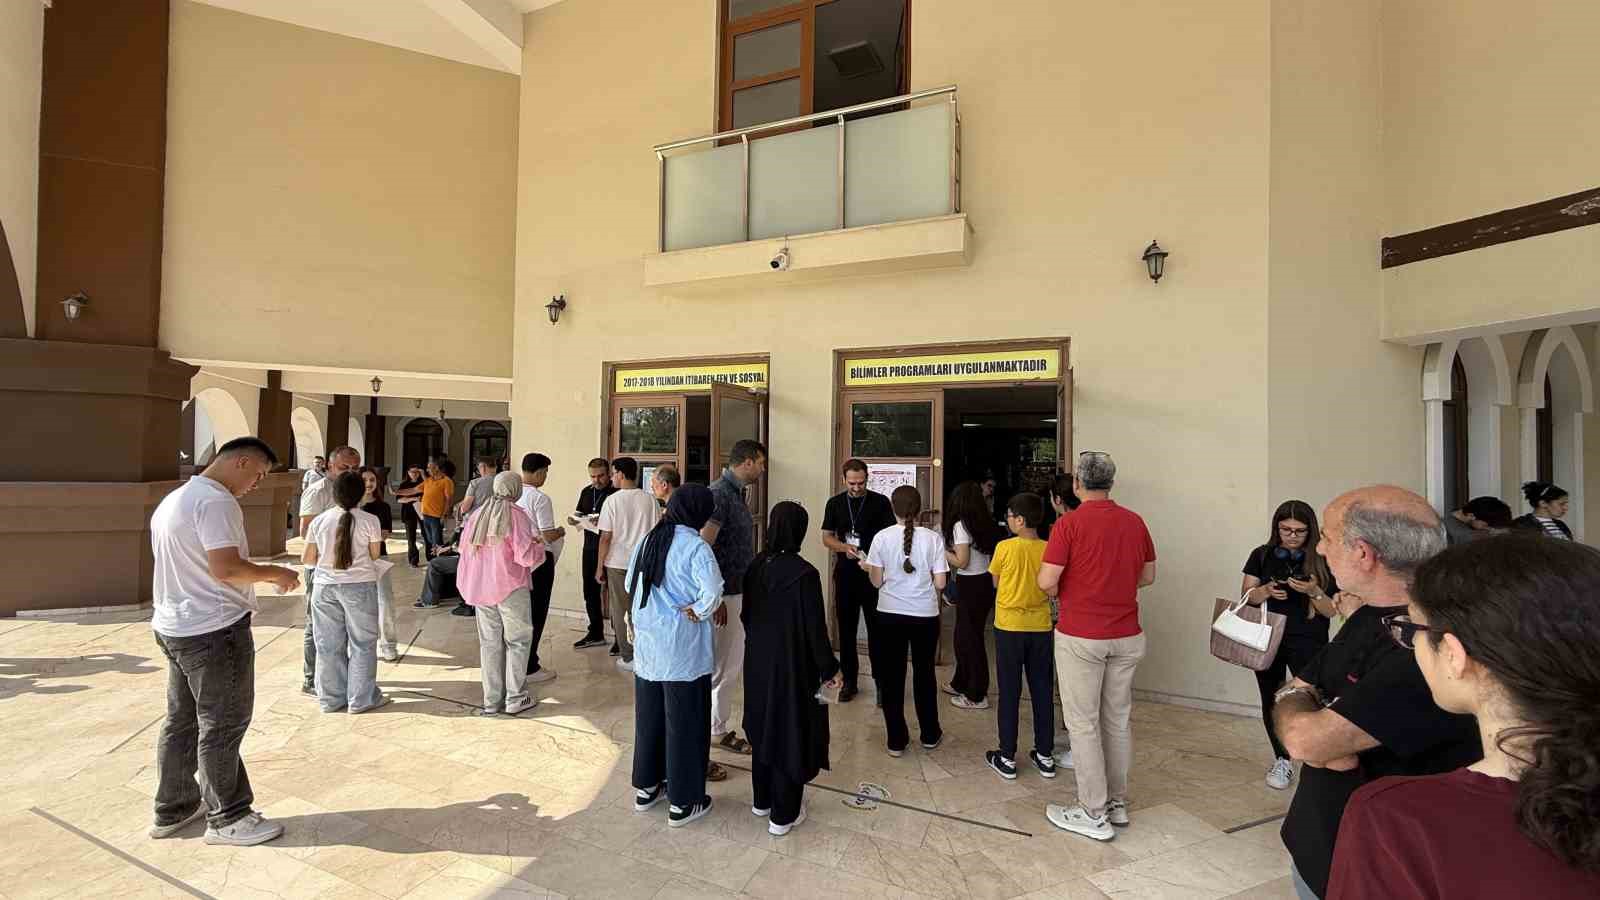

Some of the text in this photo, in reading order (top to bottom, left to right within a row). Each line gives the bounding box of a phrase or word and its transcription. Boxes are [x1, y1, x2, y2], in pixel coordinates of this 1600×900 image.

[851, 359, 1047, 378] BİLİMLER PROGRAMLARI UYGULANMAKTADIR
[623, 376, 655, 388] 2017-2018
[655, 375, 685, 386] YILINDAN
[729, 373, 738, 384] VE
[738, 371, 764, 384] SOSYAL
